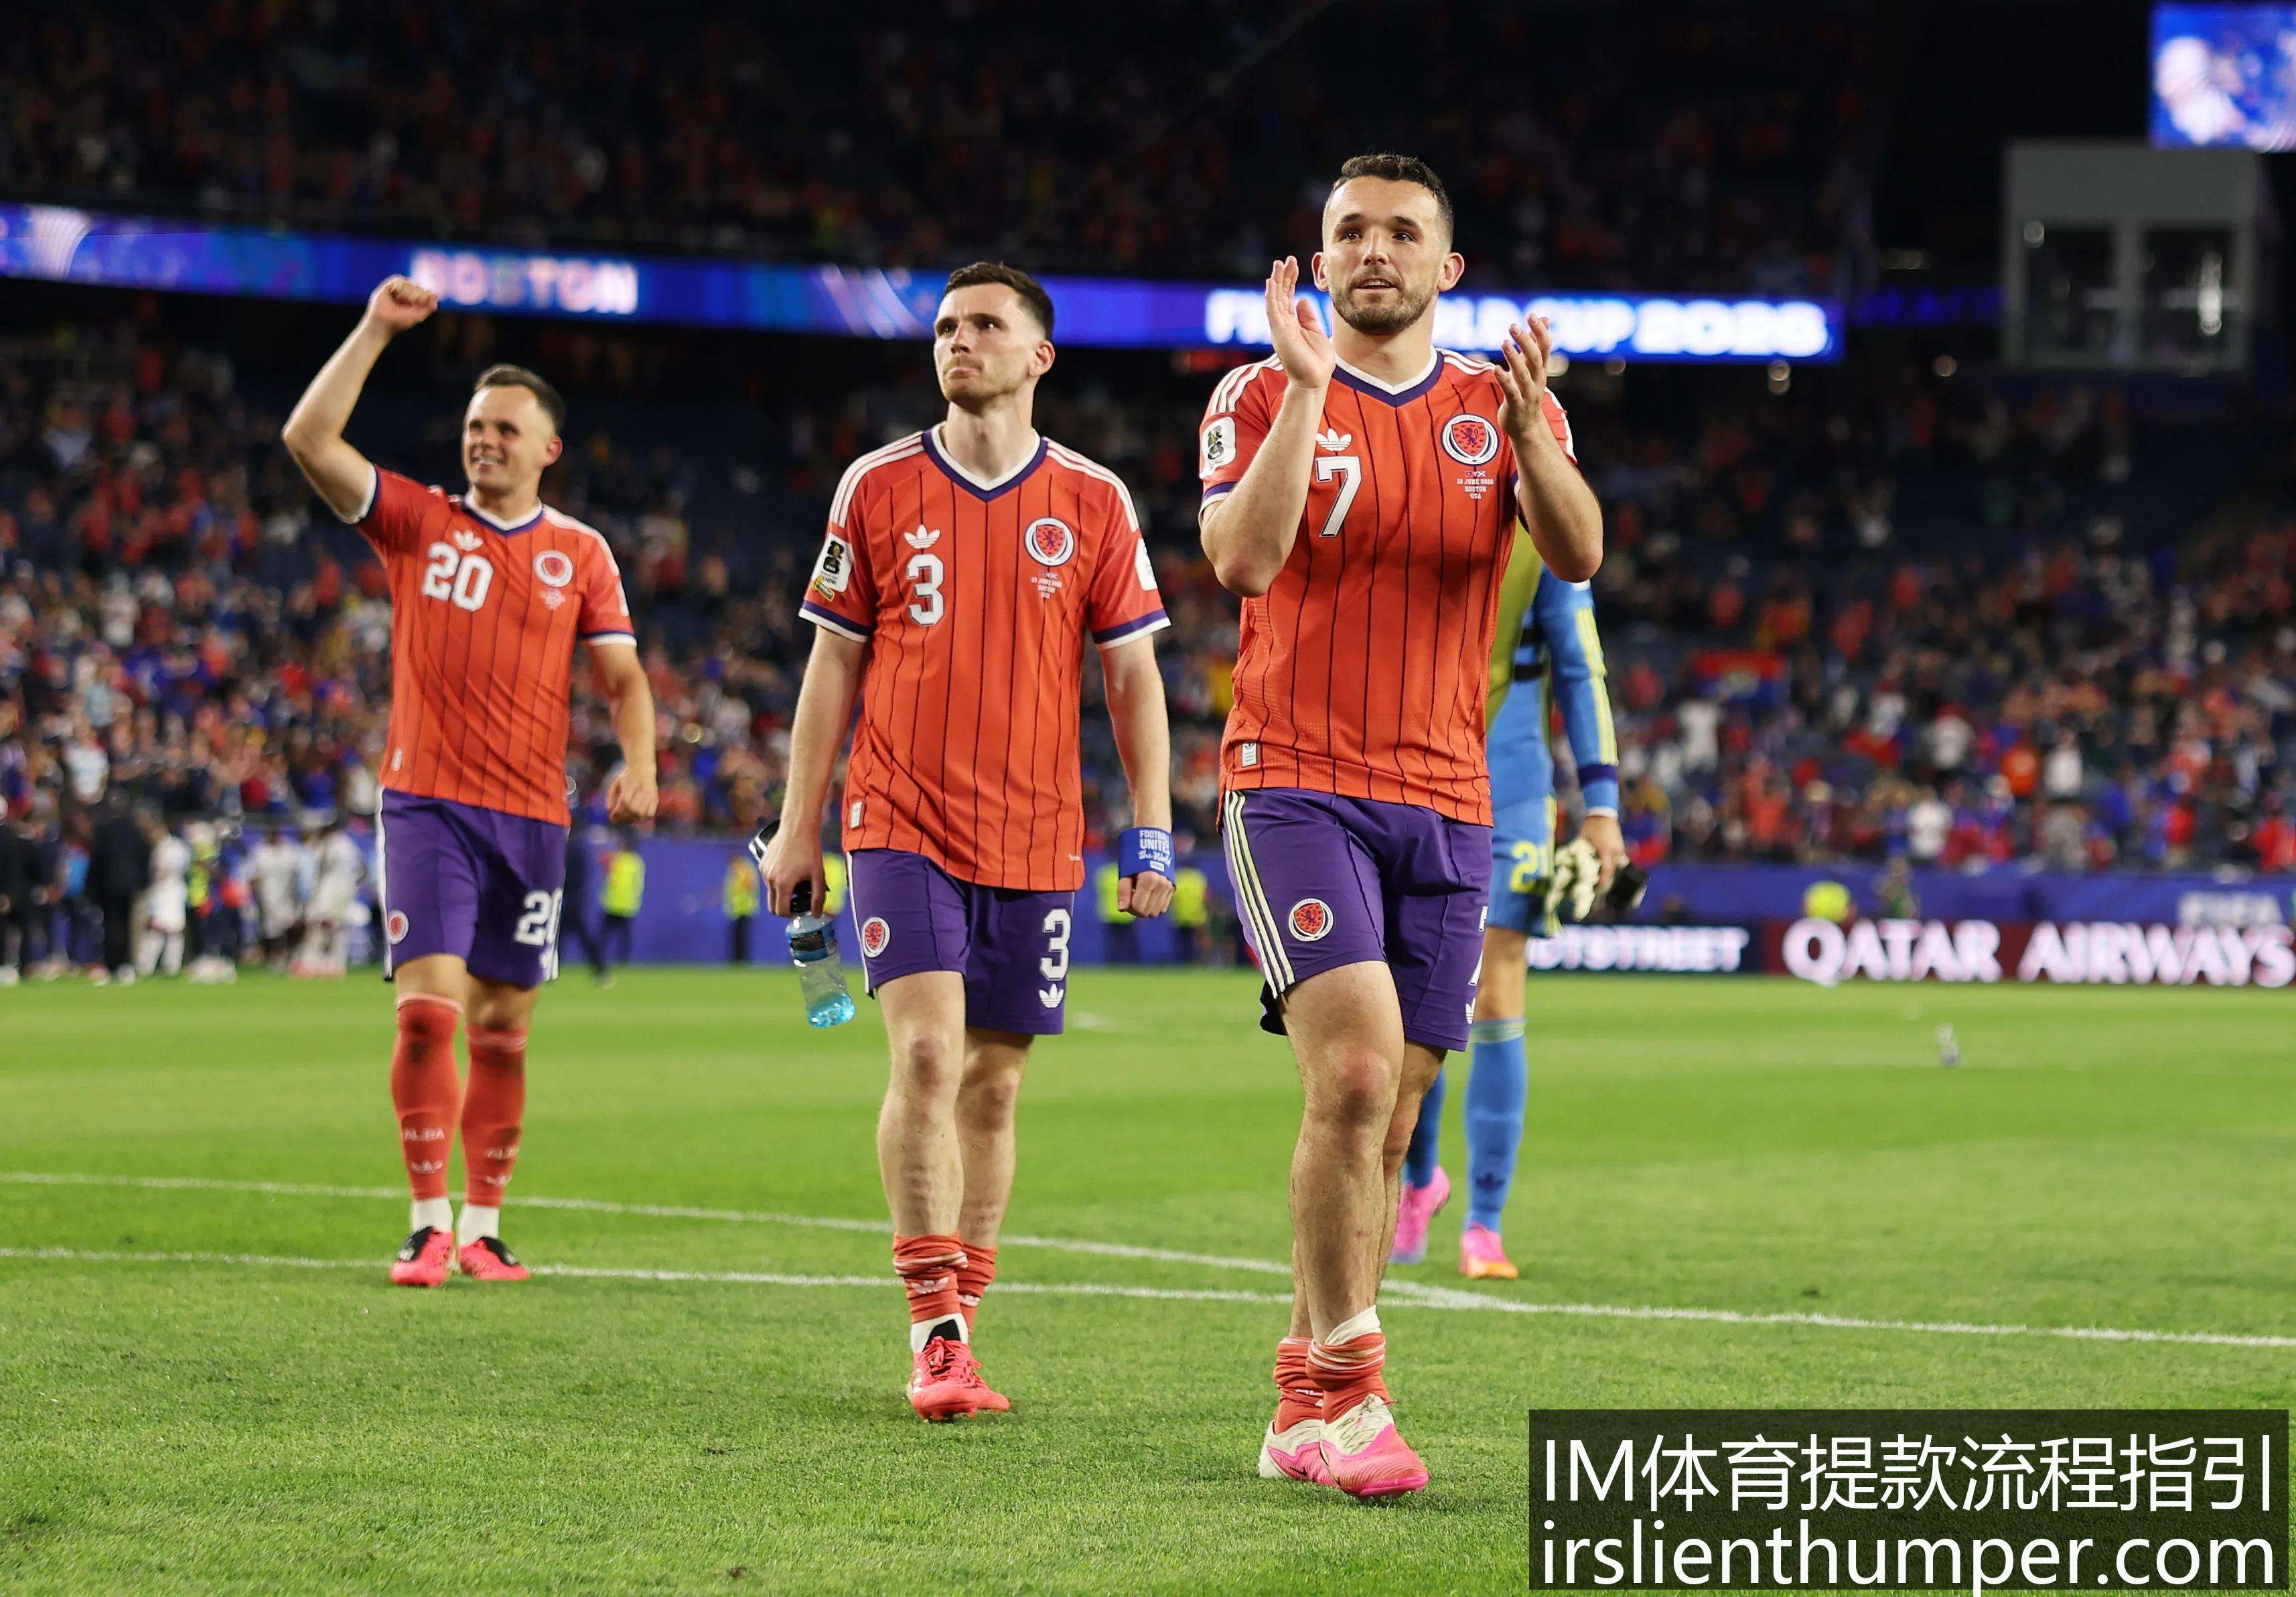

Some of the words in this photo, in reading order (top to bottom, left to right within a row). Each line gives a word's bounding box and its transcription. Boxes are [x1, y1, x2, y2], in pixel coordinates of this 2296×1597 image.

[411, 249, 638, 315] BOSTON
[1525, 297, 1636, 354] CUP
[1633, 299, 1829, 357] 2026
[1315, 456, 1362, 537] 7
[422, 541, 494, 612] 20
[907, 553, 944, 626] 3
[1039, 908, 1072, 981] 3
[1782, 917, 2004, 987] QATAR
[2017, 919, 2296, 988] AIRWAYS
